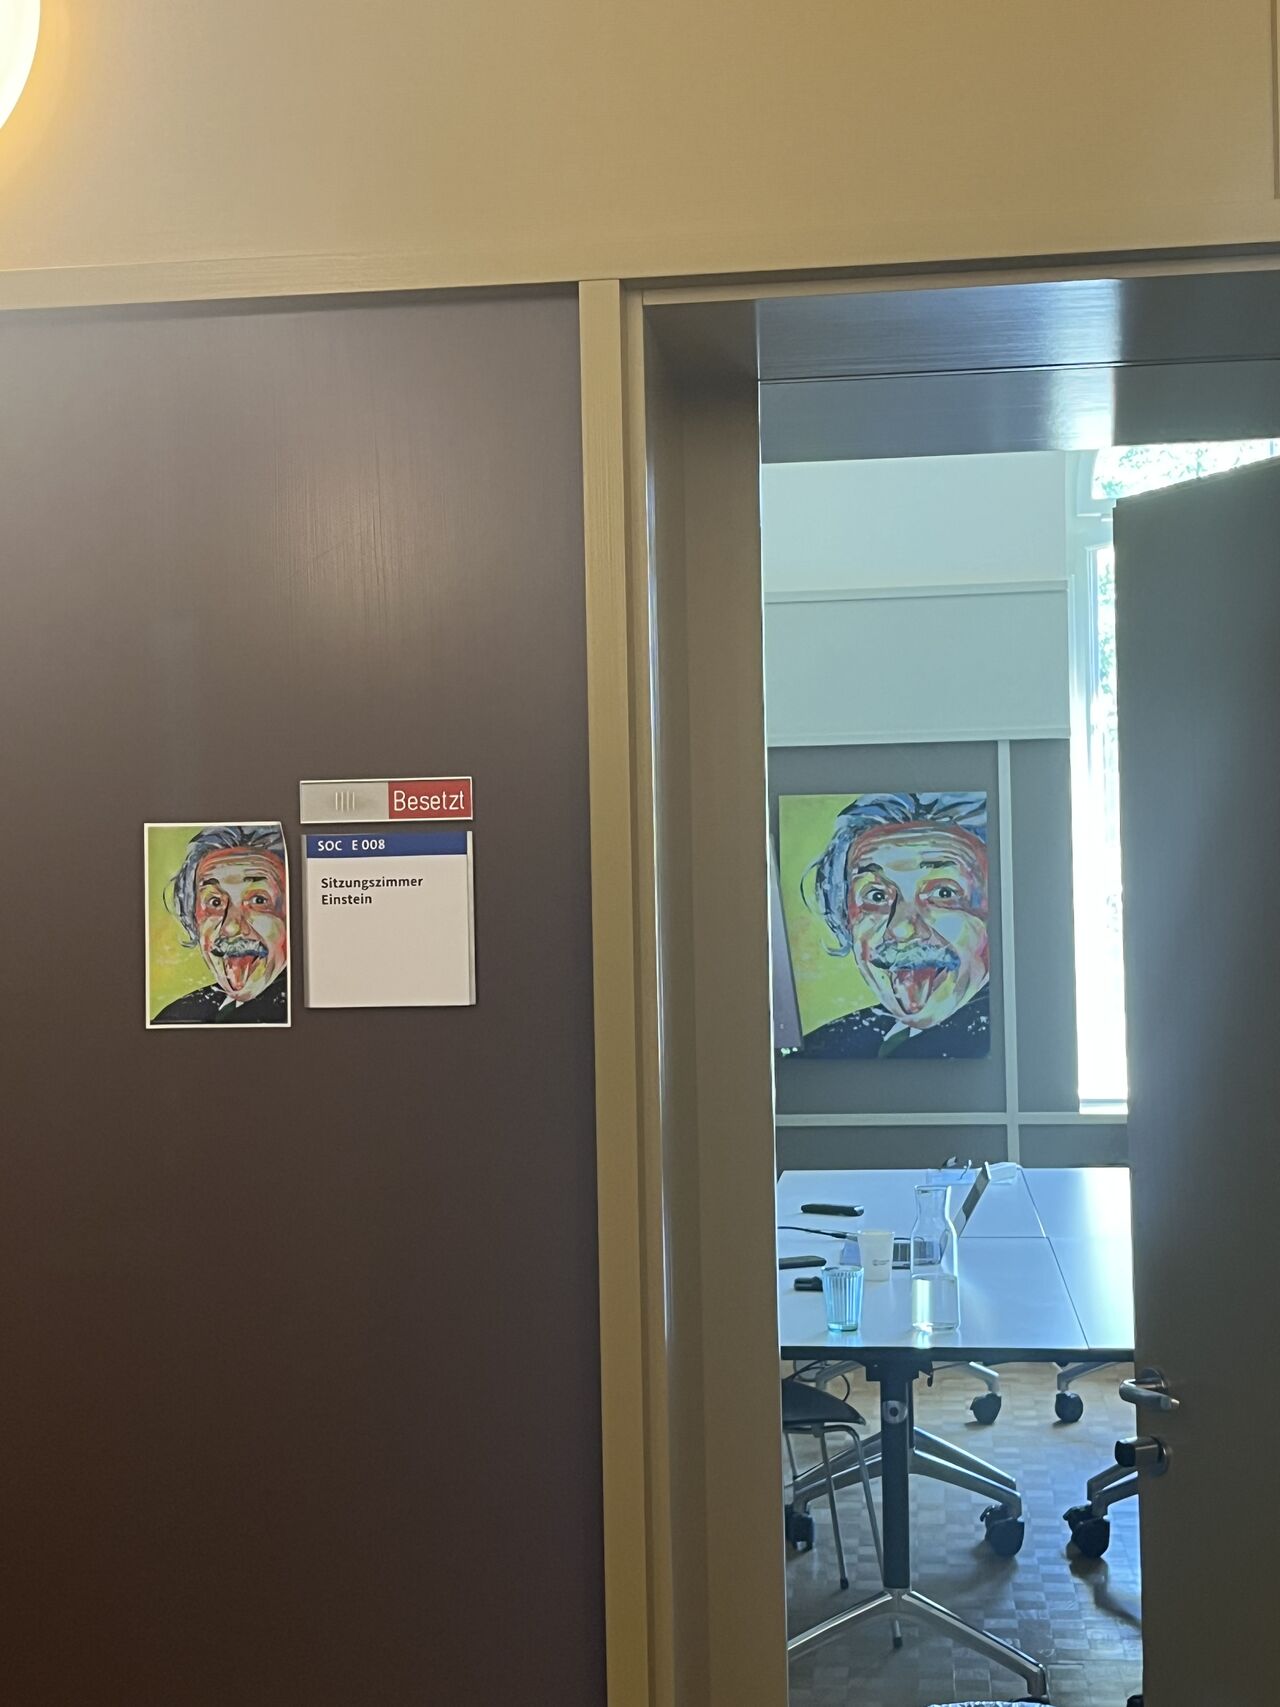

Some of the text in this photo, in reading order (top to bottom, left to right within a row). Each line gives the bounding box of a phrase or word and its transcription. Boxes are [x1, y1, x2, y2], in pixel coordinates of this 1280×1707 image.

[393, 790, 465, 812] Besetzt
[317, 839, 386, 851] SOC E 008
[321, 876, 423, 891] Sitzungszimmer
[321, 893, 372, 905] Einstein
